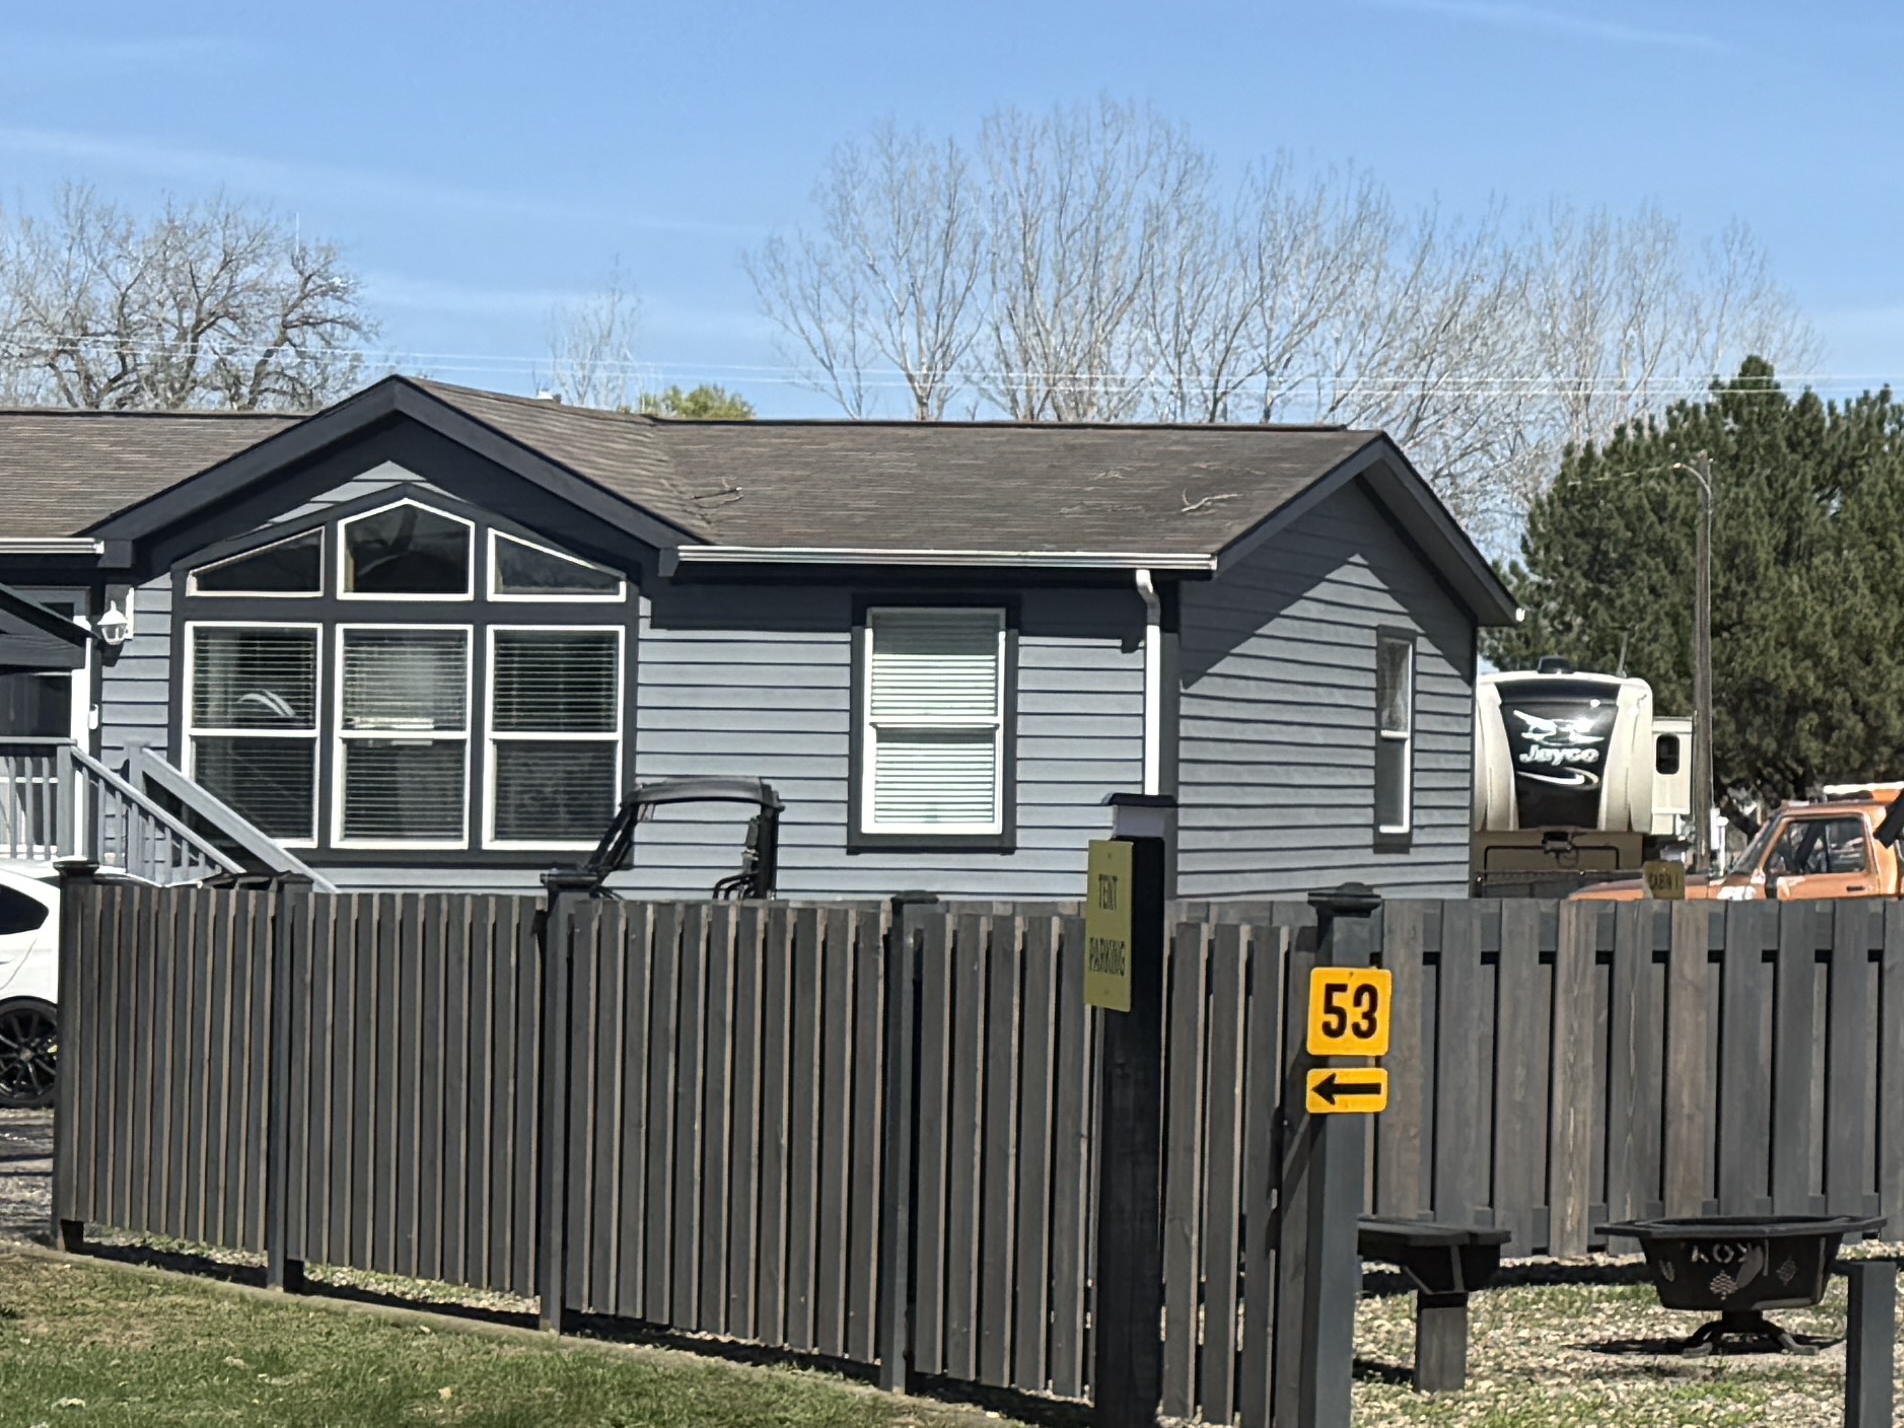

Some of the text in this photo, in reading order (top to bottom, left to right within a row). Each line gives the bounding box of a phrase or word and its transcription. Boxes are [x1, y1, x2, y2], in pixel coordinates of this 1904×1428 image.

[1518, 744, 1600, 766] Jayco
[1098, 873, 1119, 910] TENT
[1088, 936, 1126, 977] PARKING
[1322, 983, 1379, 1039] 53
